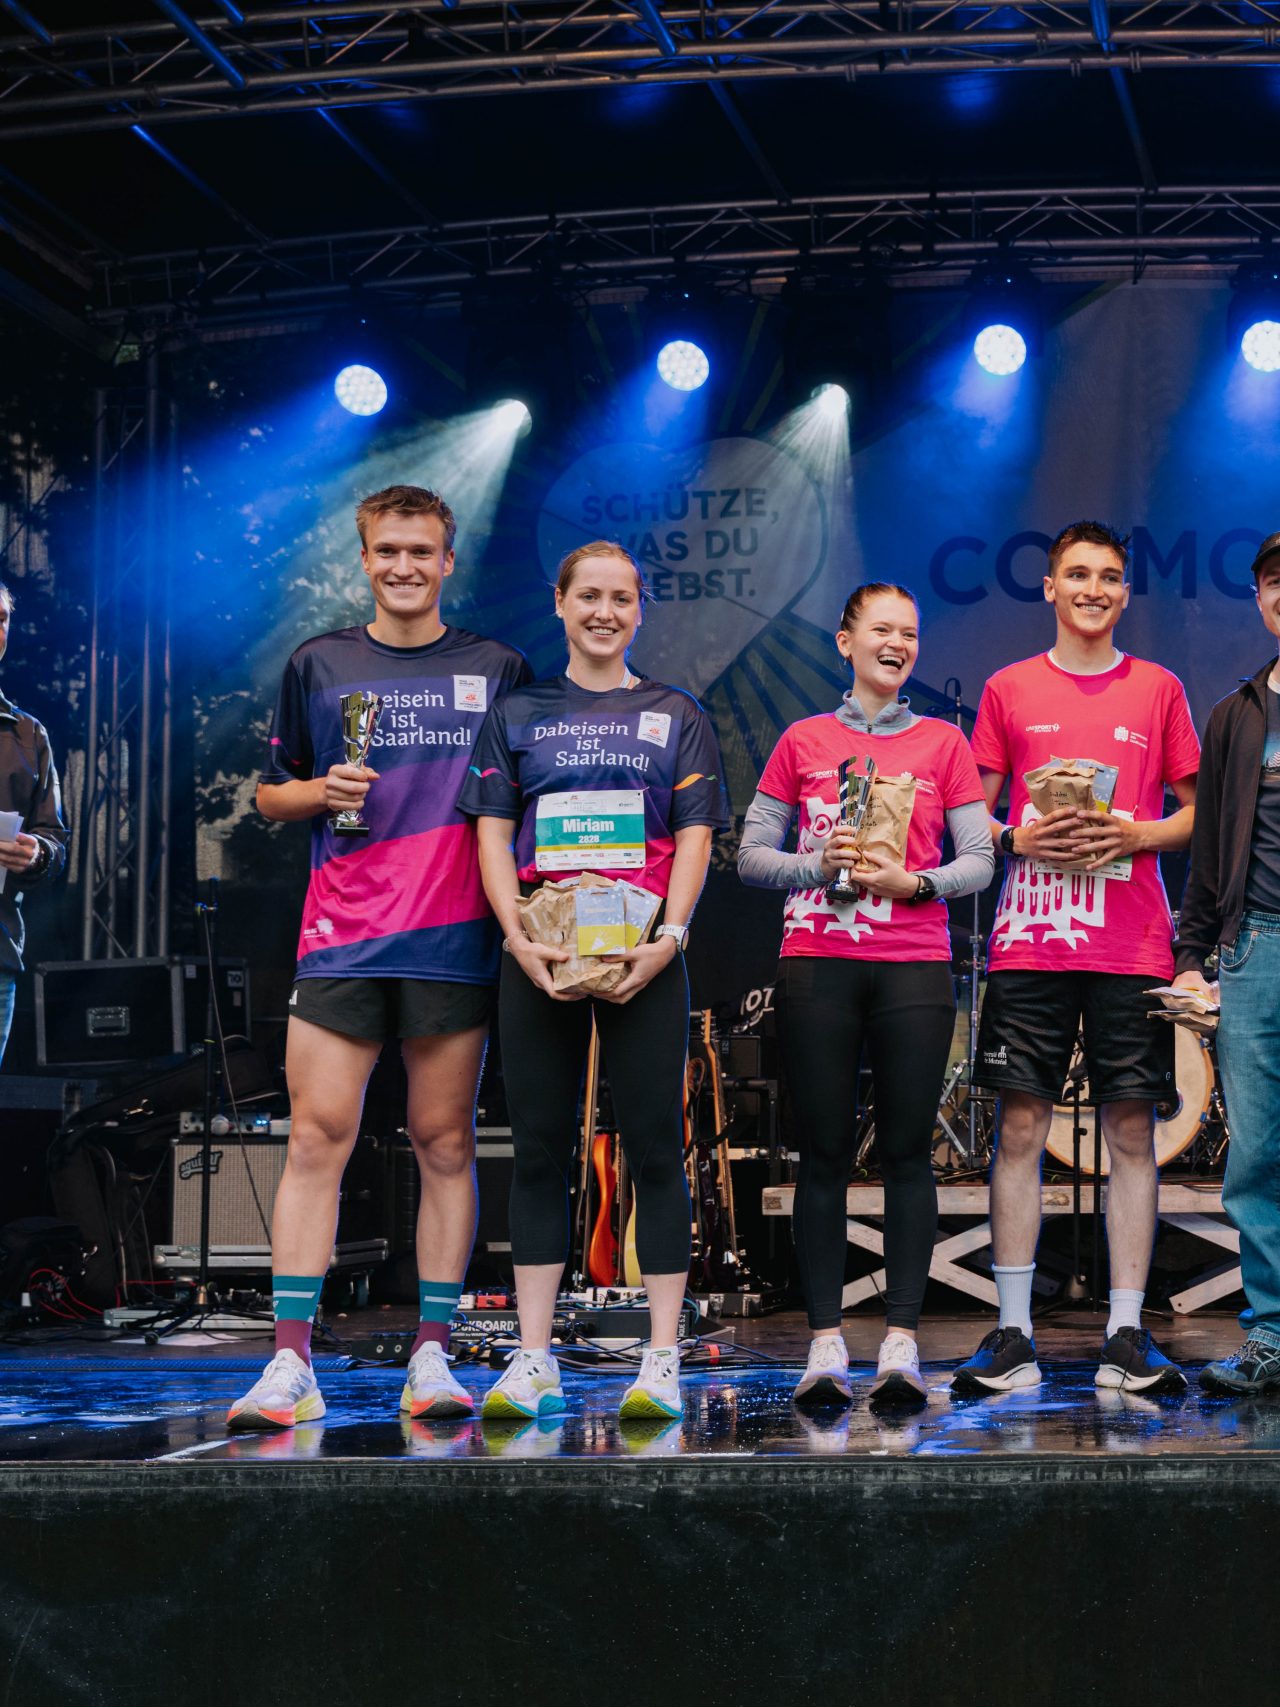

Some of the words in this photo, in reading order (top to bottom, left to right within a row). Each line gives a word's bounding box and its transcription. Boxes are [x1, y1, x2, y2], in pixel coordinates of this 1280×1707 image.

[581, 482, 780, 525] SCHÜTZE,
[705, 527, 759, 560] DU
[648, 568, 756, 602] EBST.
[341, 690, 445, 708] eisein
[391, 711, 417, 728] ist
[371, 726, 471, 747] Saarland!
[533, 721, 629, 741] Dabeisein
[576, 736, 600, 750] ist
[555, 749, 650, 773] Saarland!
[562, 818, 615, 833] Miriam
[578, 835, 600, 844] 2828
